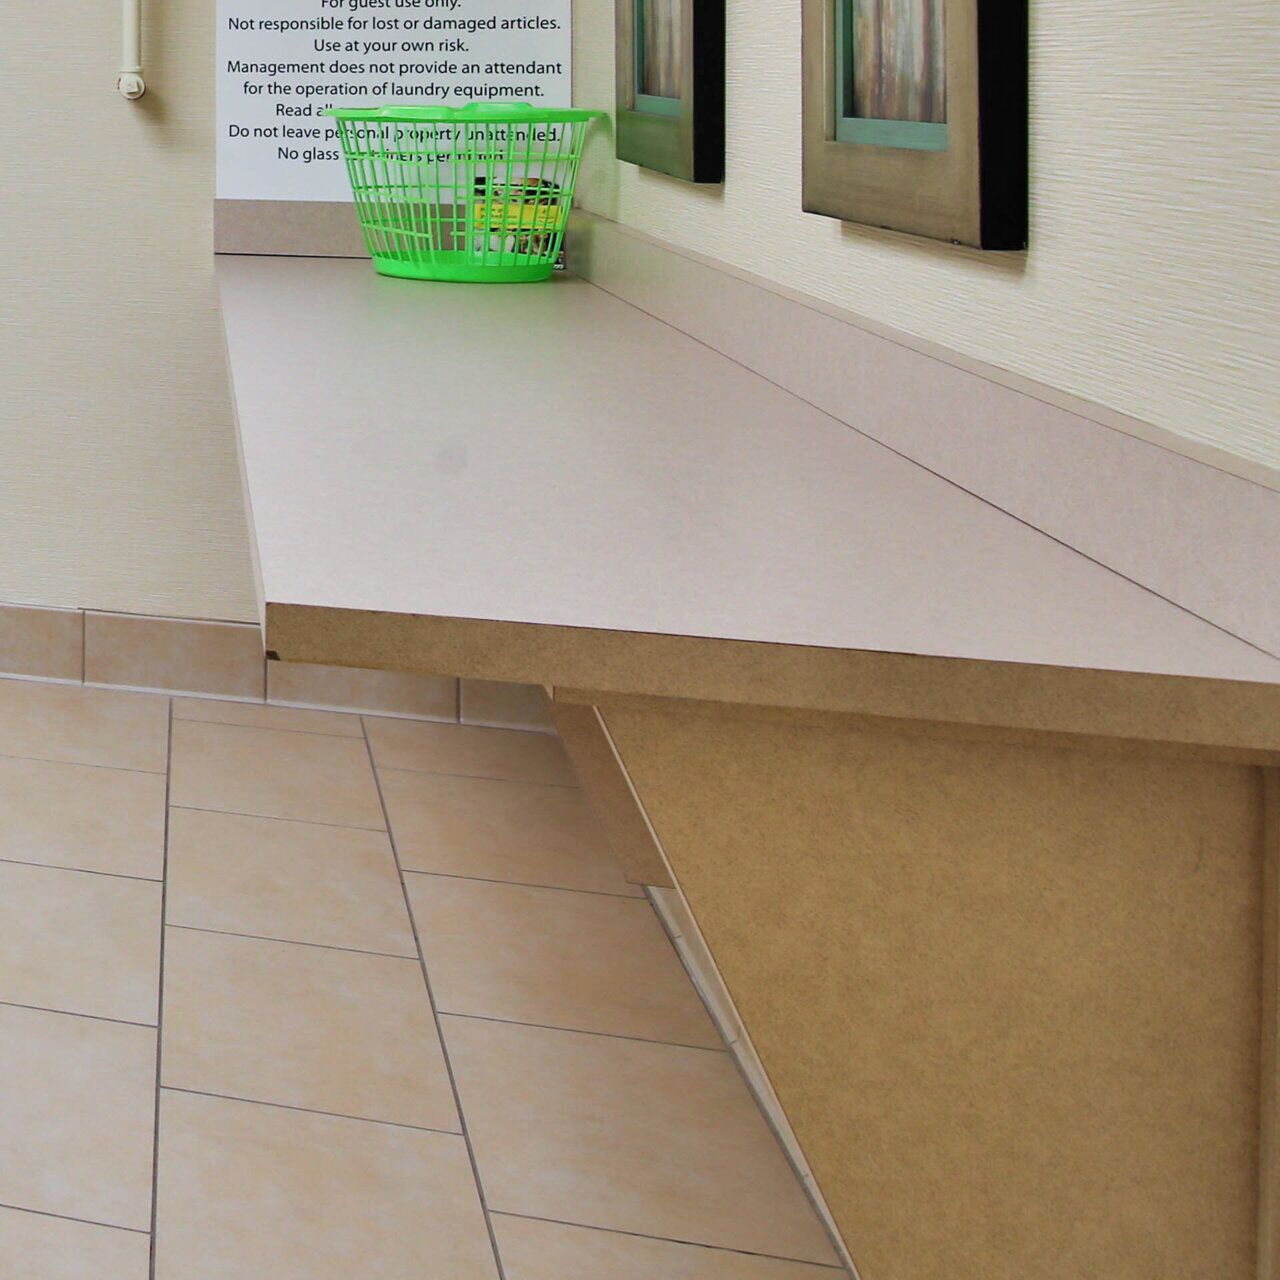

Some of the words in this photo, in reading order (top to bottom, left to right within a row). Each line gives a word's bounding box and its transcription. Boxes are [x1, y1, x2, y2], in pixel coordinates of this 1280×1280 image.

[228, 17, 255, 30] Not
[258, 17, 344, 32] responsible
[347, 16, 368, 30] for
[372, 17, 399, 30] lost
[403, 19, 419, 30] or
[423, 16, 496, 33] damaged
[500, 16, 561, 30] articles.
[314, 38, 341, 52] Use
[344, 40, 360, 52] at
[363, 41, 398, 54] your
[401, 41, 434, 52] own
[438, 38, 469, 52] risk.
[227, 60, 325, 76] Management
[329, 60, 365, 74] does
[369, 62, 395, 74] not
[399, 61, 458, 76] provide
[461, 63, 480, 74] an
[484, 61, 562, 74] attendant
[243, 81, 264, 94] for
[267, 81, 292, 95] the
[295, 82, 368, 97] operation
[372, 82, 389, 95] of
[391, 82, 450, 99] laundry
[453, 83, 545, 99] equipment.
[276, 103, 312, 117] Read
[229, 124, 250, 138] Do
[253, 126, 278, 138] not
[282, 125, 321, 138] leave
[325, 126, 389, 142] pesonal
[393, 128, 461, 143] poperty
[278, 147, 299, 160] No
[302, 147, 339, 163] glass
